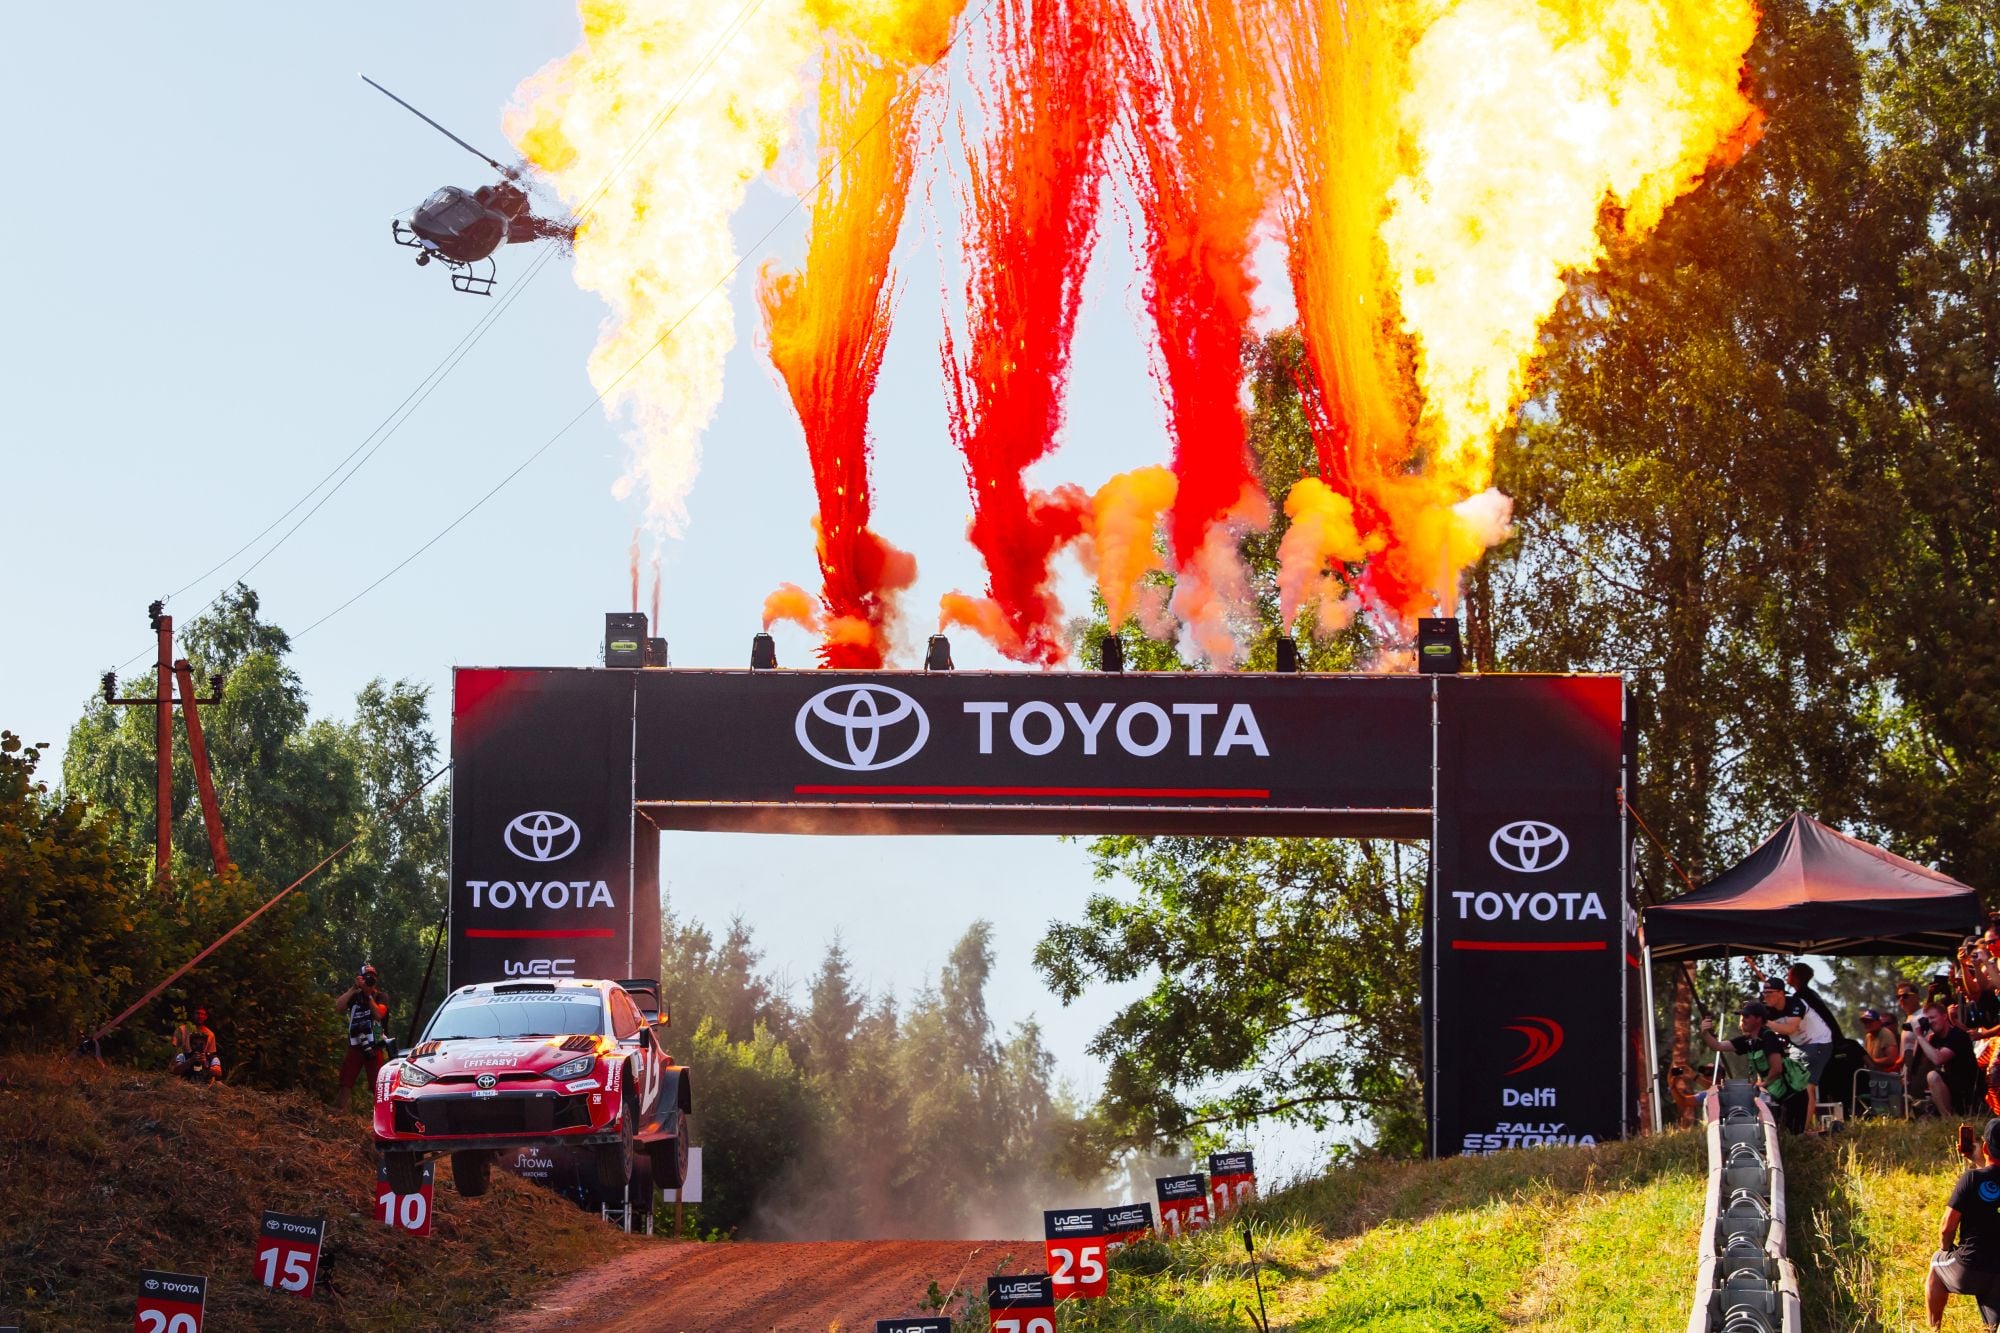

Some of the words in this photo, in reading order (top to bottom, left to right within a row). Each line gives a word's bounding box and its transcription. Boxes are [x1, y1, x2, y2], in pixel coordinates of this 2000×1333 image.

[963, 700, 1270, 757] TOYOTA
[466, 880, 615, 910] TOYOTA
[1452, 891, 1607, 921] TOYOTA
[504, 959, 576, 975] WRC
[1502, 1088, 1557, 1107] Delfi
[1495, 1122, 1565, 1134] RALLY
[514, 1154, 554, 1168] STOWA
[1216, 1157, 1246, 1166] WRC
[1164, 1179, 1197, 1190] WRC
[380, 1191, 427, 1229] 10
[1108, 1210, 1143, 1222] WRC
[1054, 1214, 1093, 1226] WRC
[1164, 1205, 1206, 1237] 15
[282, 1222, 317, 1235] TOYOTA
[260, 1247, 312, 1291] 15
[1050, 1246, 1104, 1284] 25
[162, 1282, 200, 1294] TOYOTA
[1000, 1282, 1042, 1294] WRC
